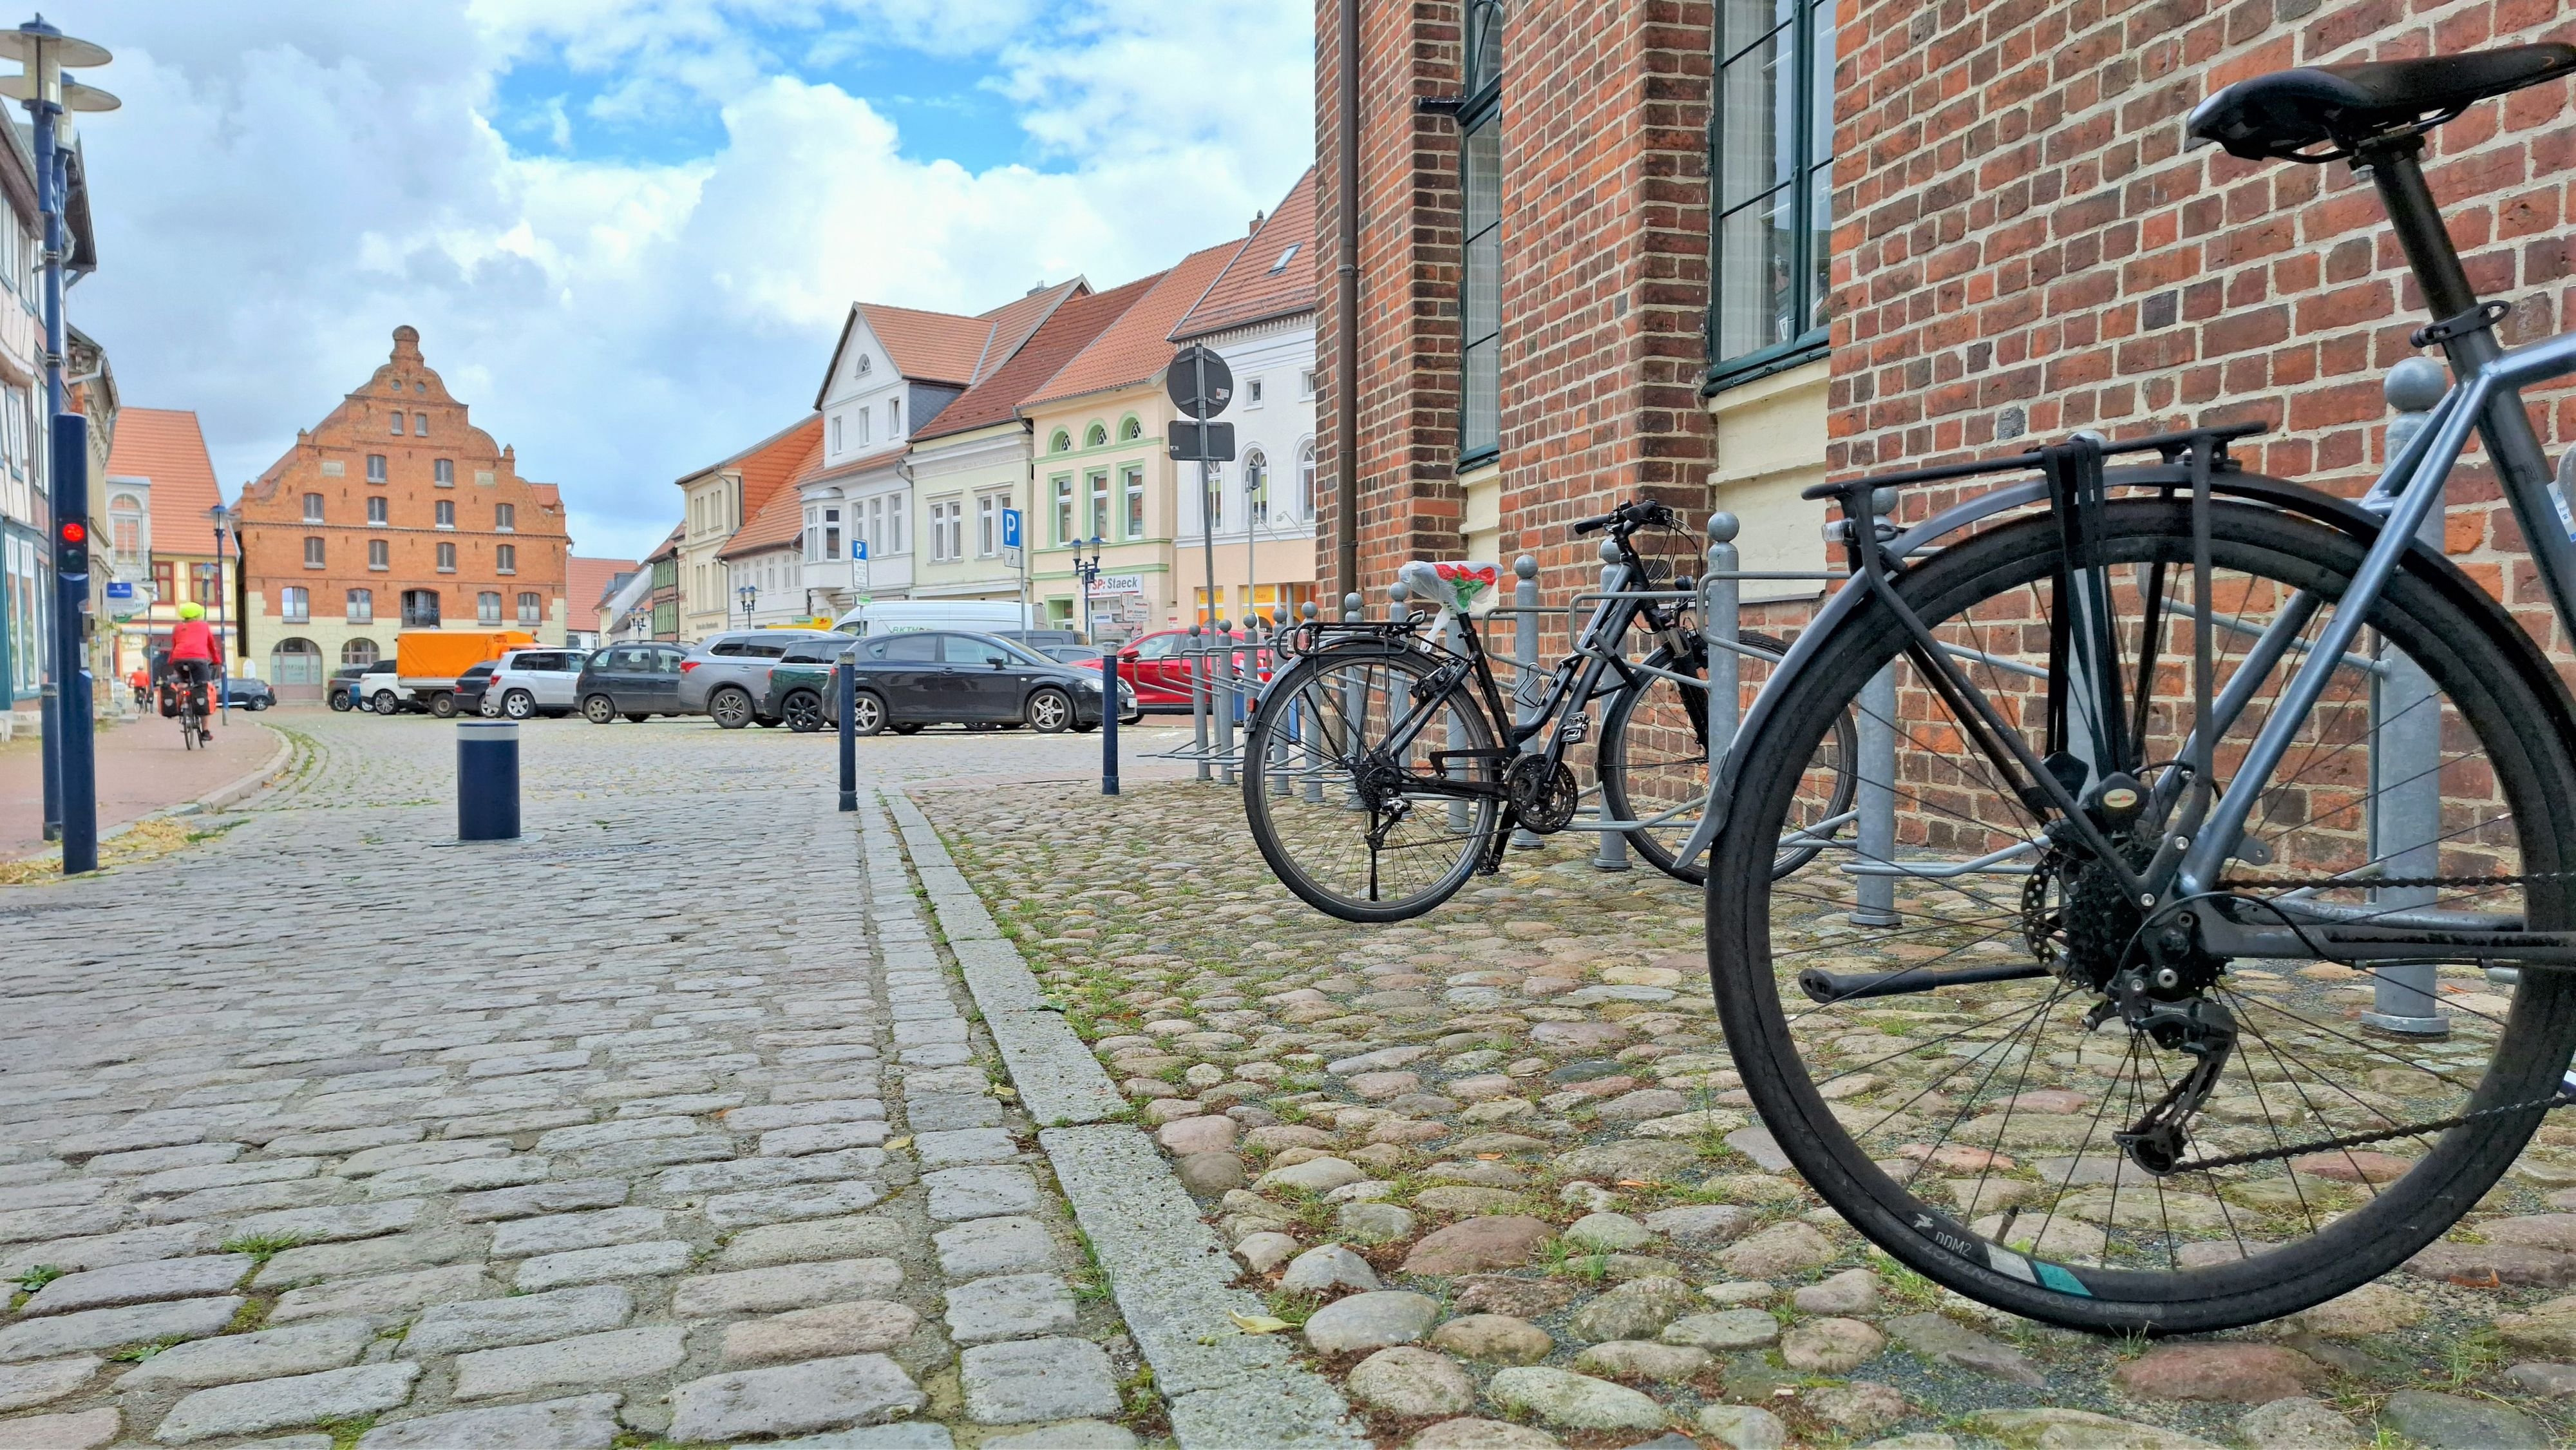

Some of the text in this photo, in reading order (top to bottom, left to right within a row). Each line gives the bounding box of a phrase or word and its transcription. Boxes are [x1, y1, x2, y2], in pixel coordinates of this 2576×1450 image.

[1007, 513, 1016, 542] P
[857, 542, 862, 557] P
[1107, 577, 1139, 589] Staeck
